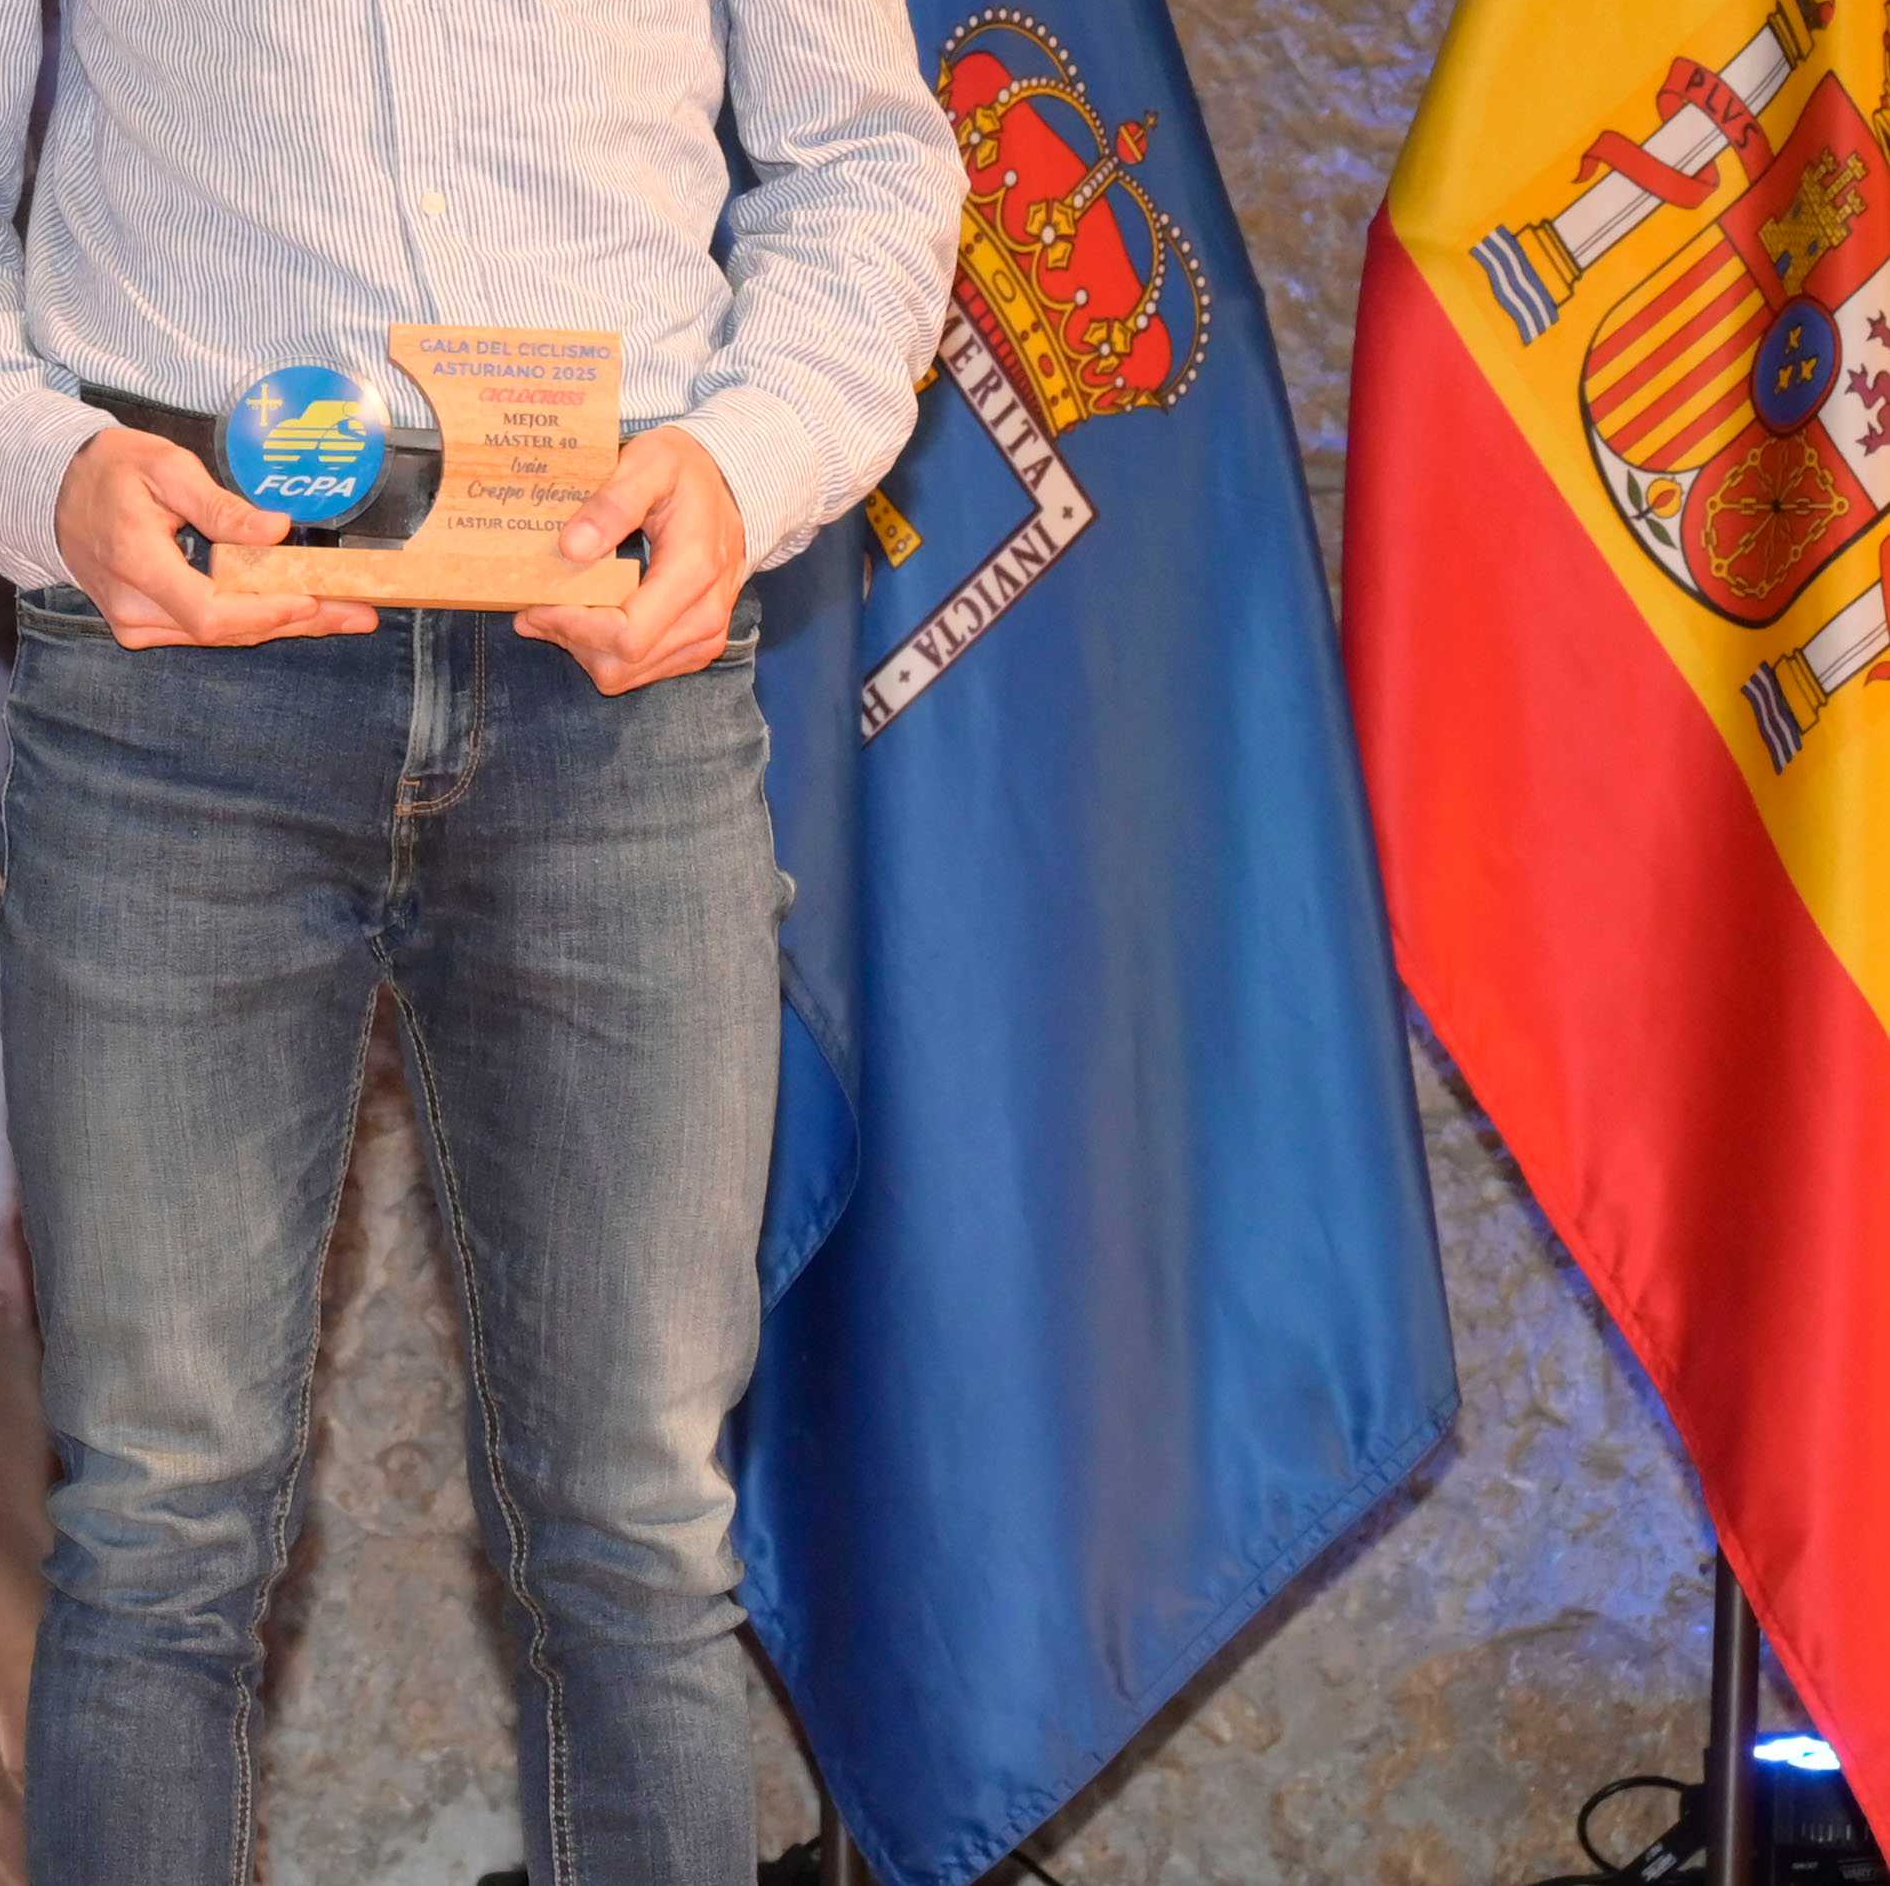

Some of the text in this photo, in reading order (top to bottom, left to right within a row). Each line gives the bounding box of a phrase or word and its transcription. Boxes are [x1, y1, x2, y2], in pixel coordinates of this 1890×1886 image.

[420, 338, 611, 360] GALA DEL CICLISMO
[433, 361, 597, 382] ASTURIANO 2025
[942, 315, 1055, 491] ERITA
[503, 412, 560, 428] MEJOR
[484, 431, 577, 449] MÁSTER 40
[254, 474, 357, 497] FCPA
[467, 480, 525, 506] Crespo
[507, 518, 565, 532] COLLOT
[912, 520, 1059, 670] INVICTA
